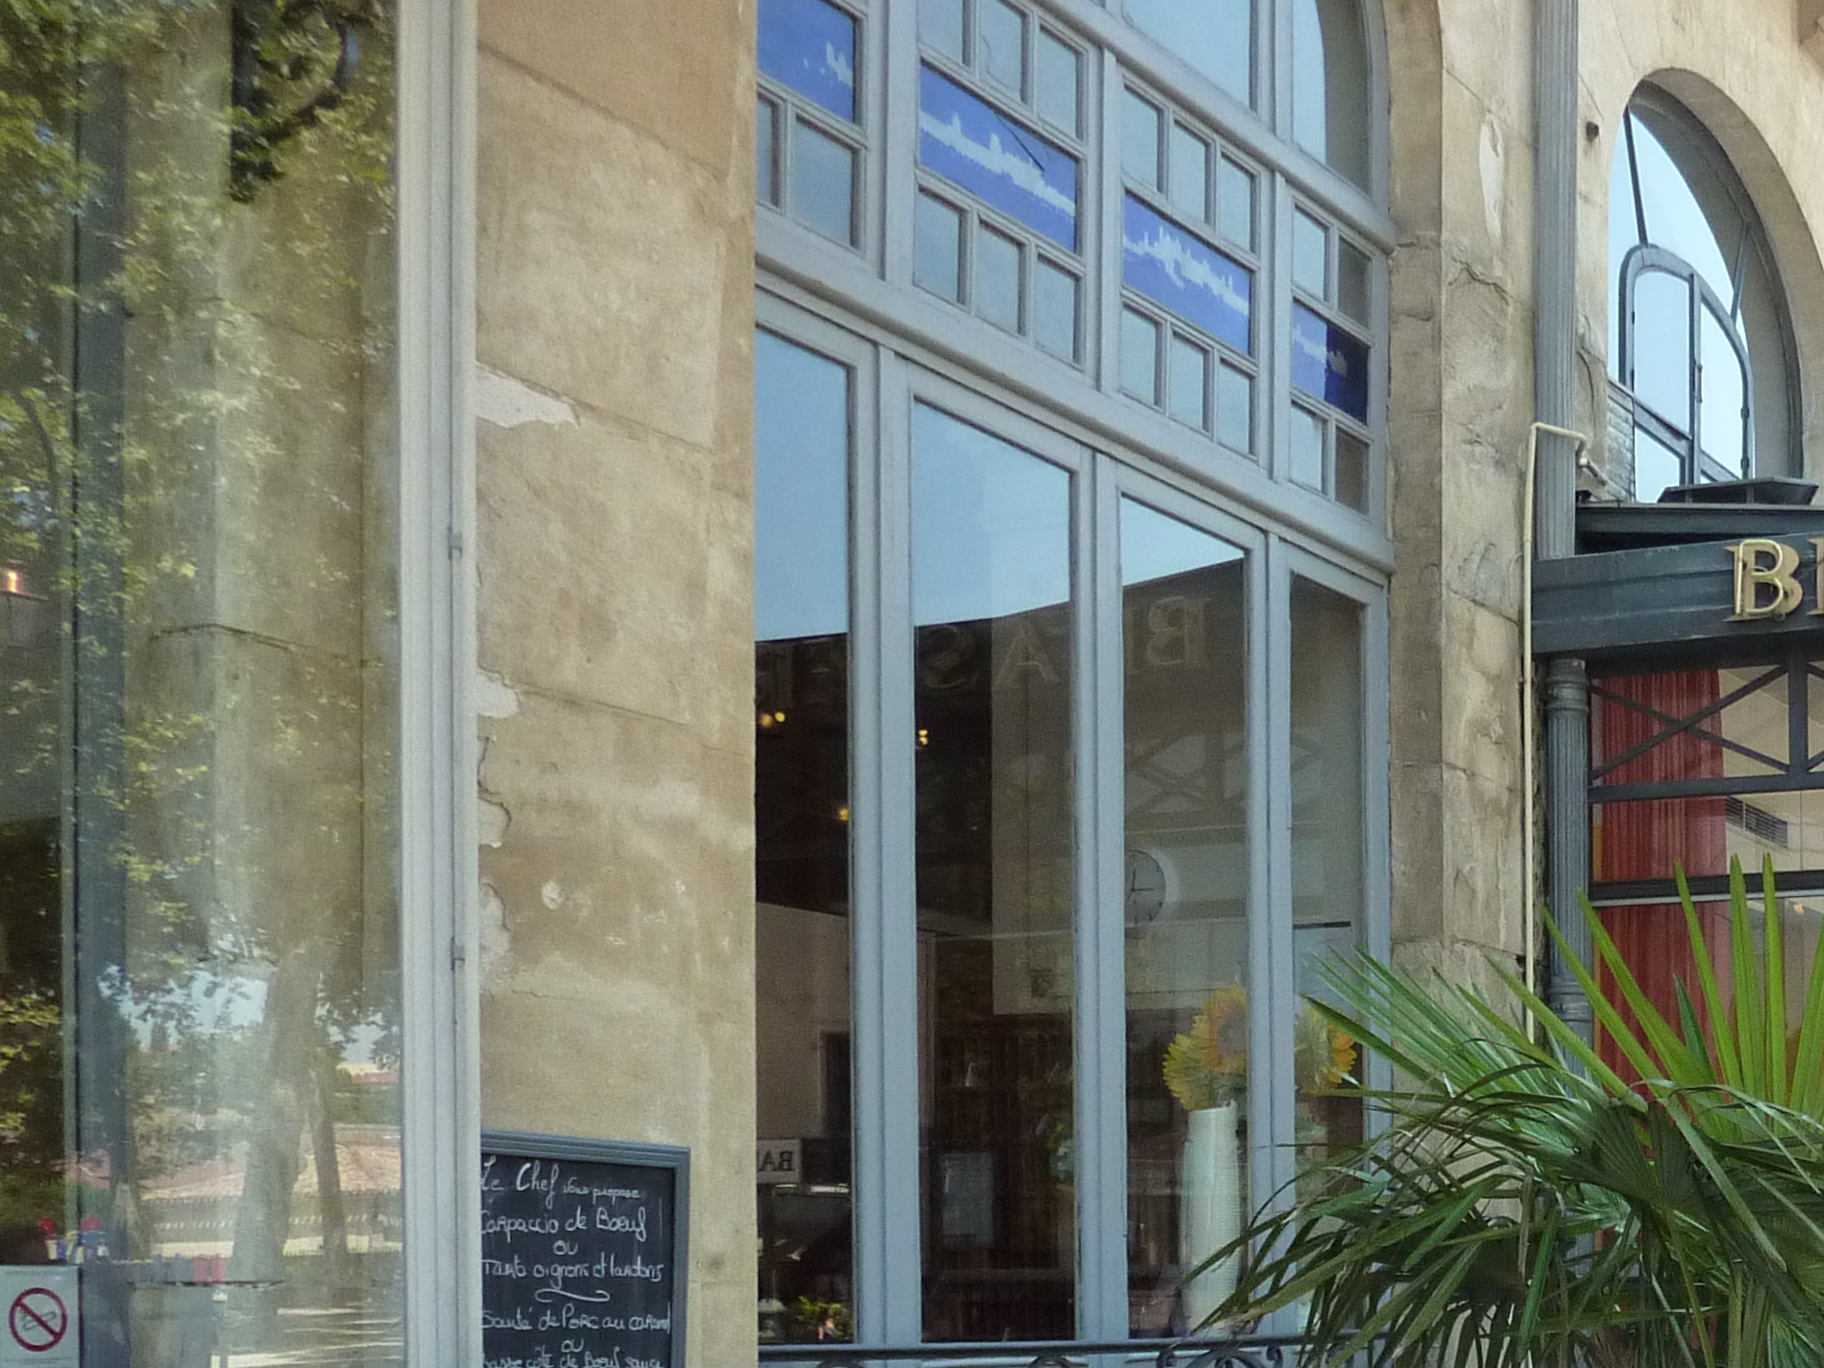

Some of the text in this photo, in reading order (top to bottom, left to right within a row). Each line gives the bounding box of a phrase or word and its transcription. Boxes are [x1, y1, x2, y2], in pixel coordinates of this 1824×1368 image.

[516, 1160, 560, 1210] Chef
[565, 1205, 588, 1231] de
[538, 1309, 561, 1331] de
[602, 1316, 626, 1330] au
[560, 1353, 578, 1368] de
